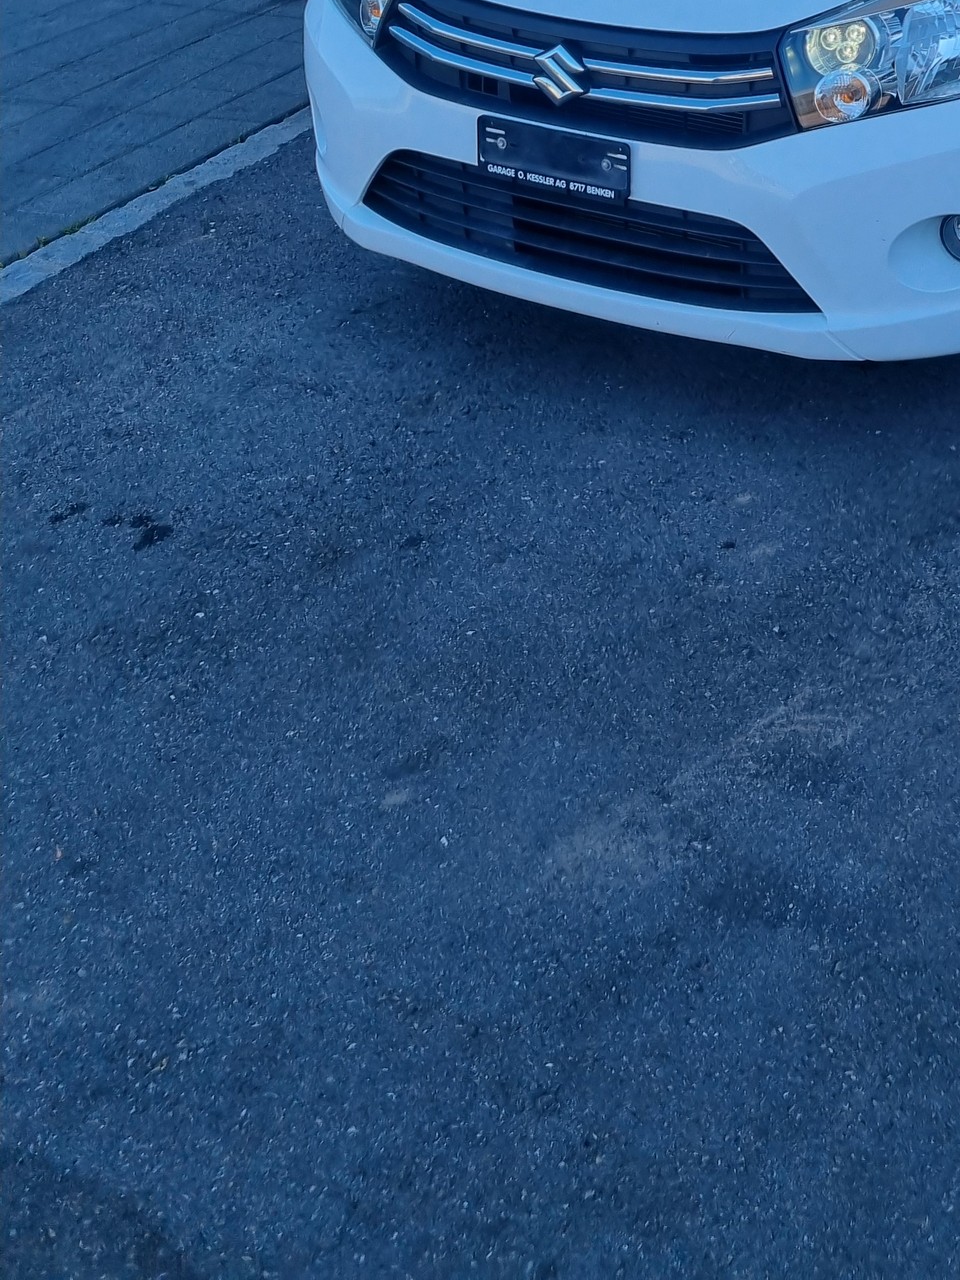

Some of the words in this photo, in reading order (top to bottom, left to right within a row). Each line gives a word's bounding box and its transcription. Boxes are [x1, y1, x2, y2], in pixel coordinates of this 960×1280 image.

[487, 164, 516, 178] GARAGE
[517, 171, 526, 180] O.
[527, 173, 555, 187] KESSLER
[555, 179, 567, 189] AG
[569, 181, 586, 192] 8717
[586, 186, 615, 199] BENKEN
